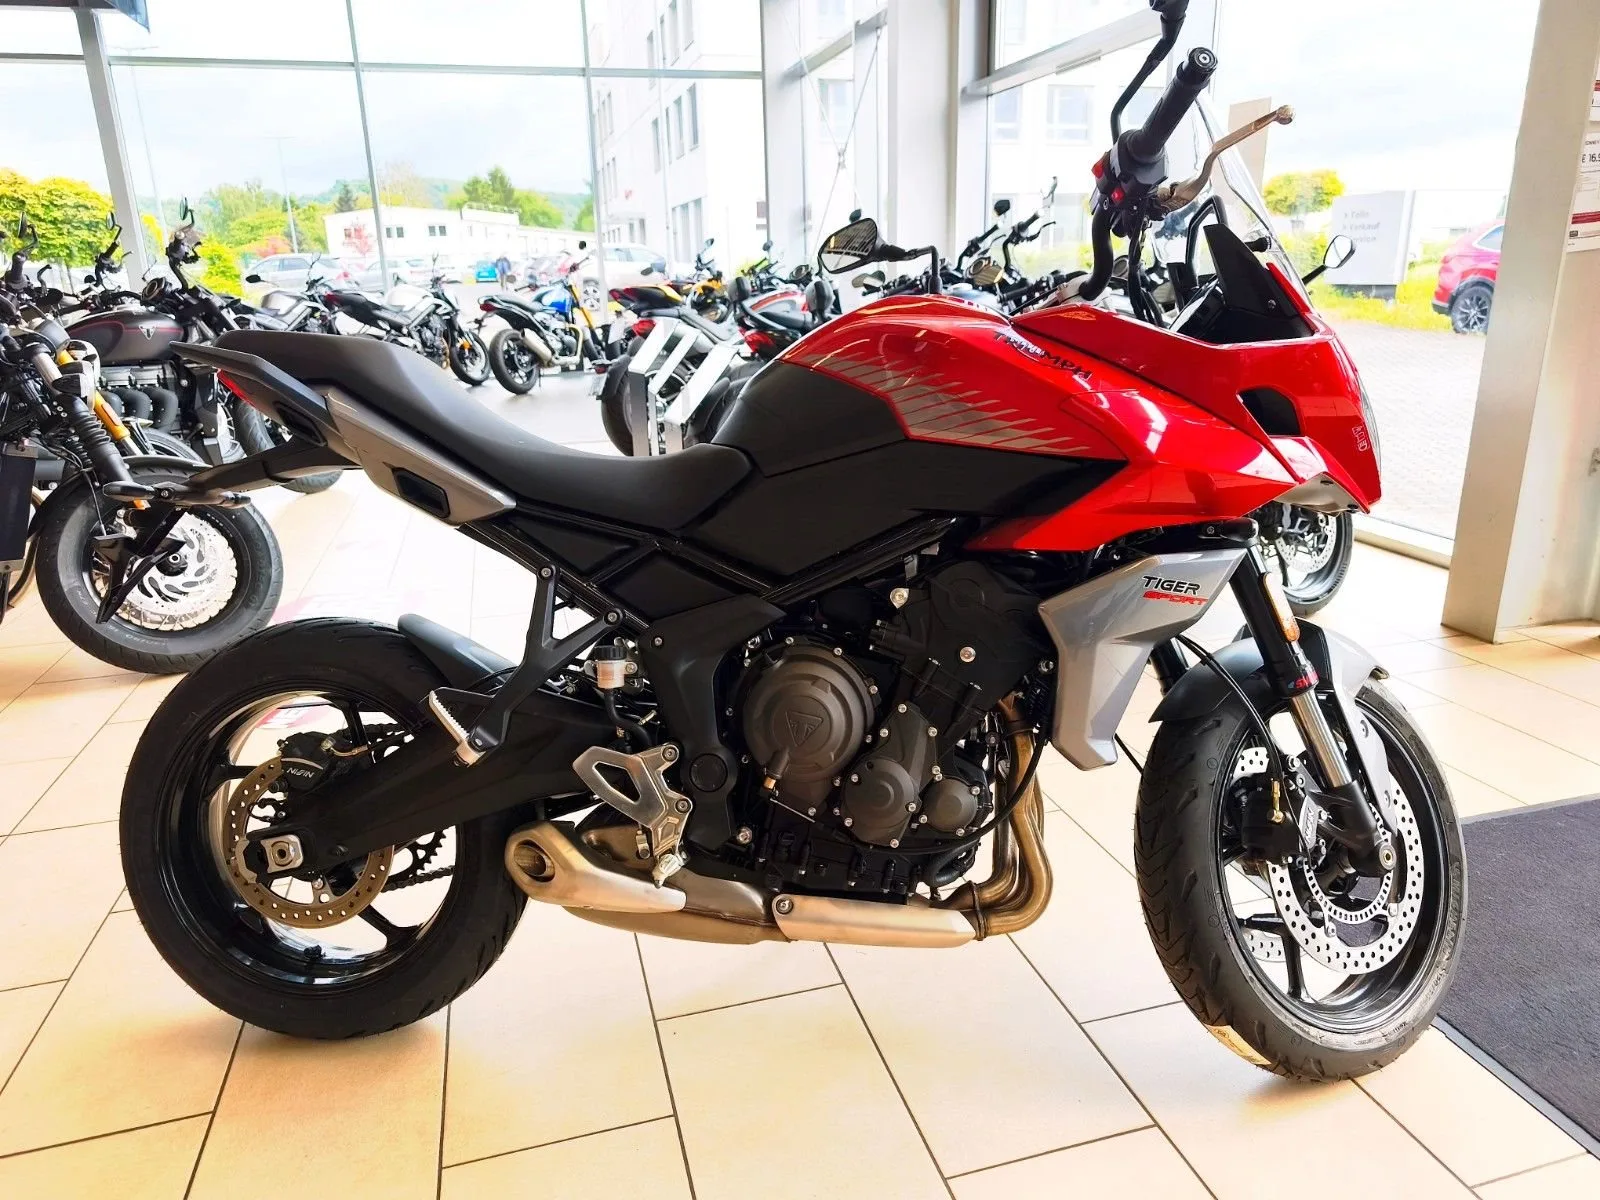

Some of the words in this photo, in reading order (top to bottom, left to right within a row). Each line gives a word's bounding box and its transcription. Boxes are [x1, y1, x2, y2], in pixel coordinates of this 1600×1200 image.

[1349, 221, 1381, 231] Verkauf
[994, 330, 1093, 380] TRIUMPH
[1143, 575, 1201, 596] TIGER
[1143, 590, 1209, 606] SPORT
